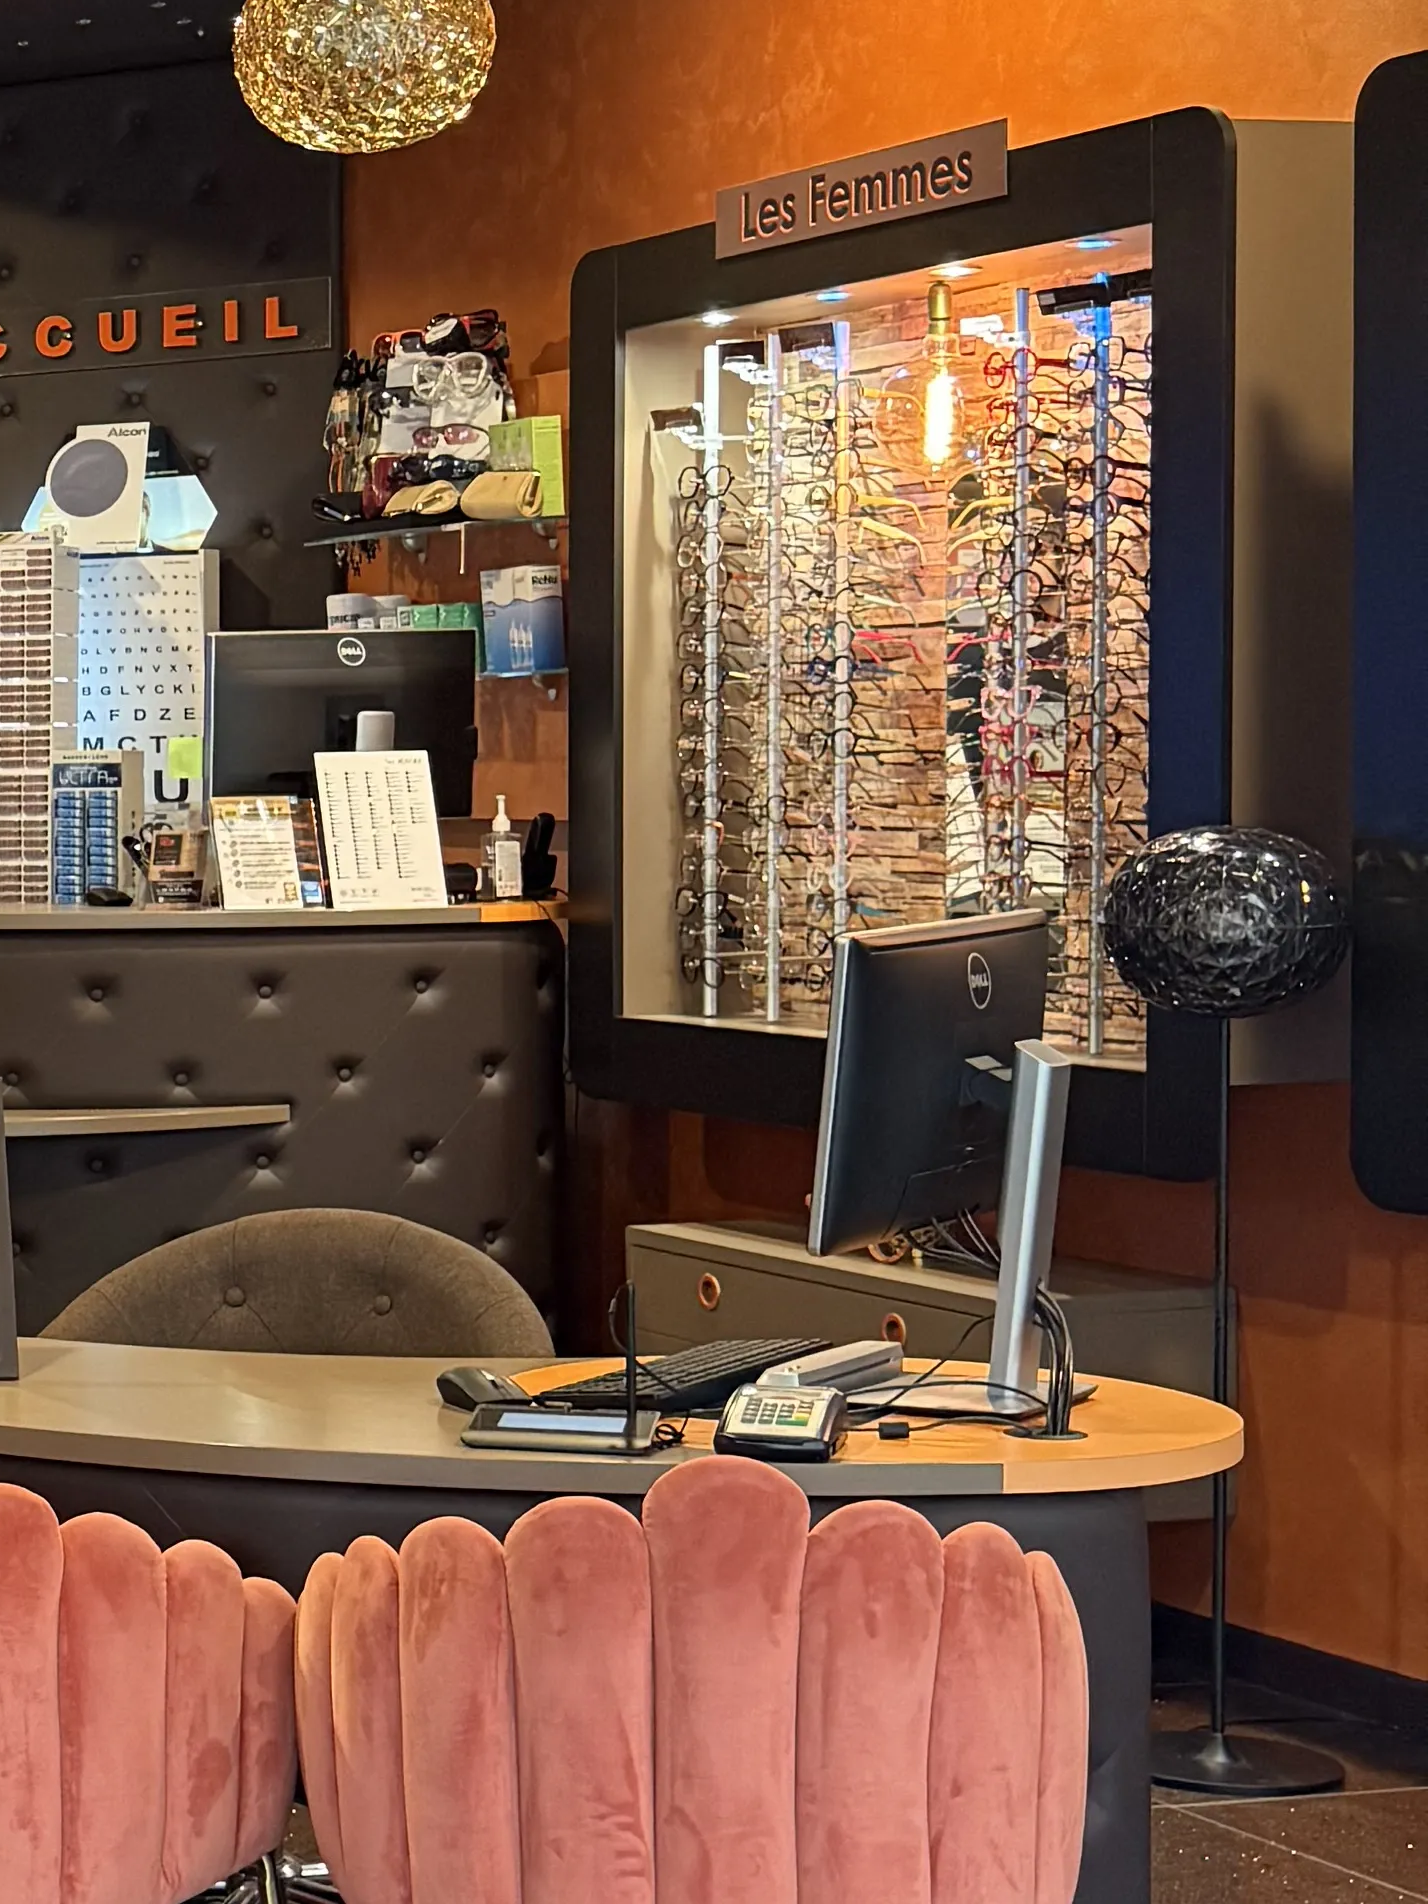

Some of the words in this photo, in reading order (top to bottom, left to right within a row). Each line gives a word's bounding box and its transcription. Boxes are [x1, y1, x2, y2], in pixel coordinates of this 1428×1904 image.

[738, 191, 796, 244] Les
[808, 147, 974, 228] Femmes
[107, 426, 147, 437] Alcon
